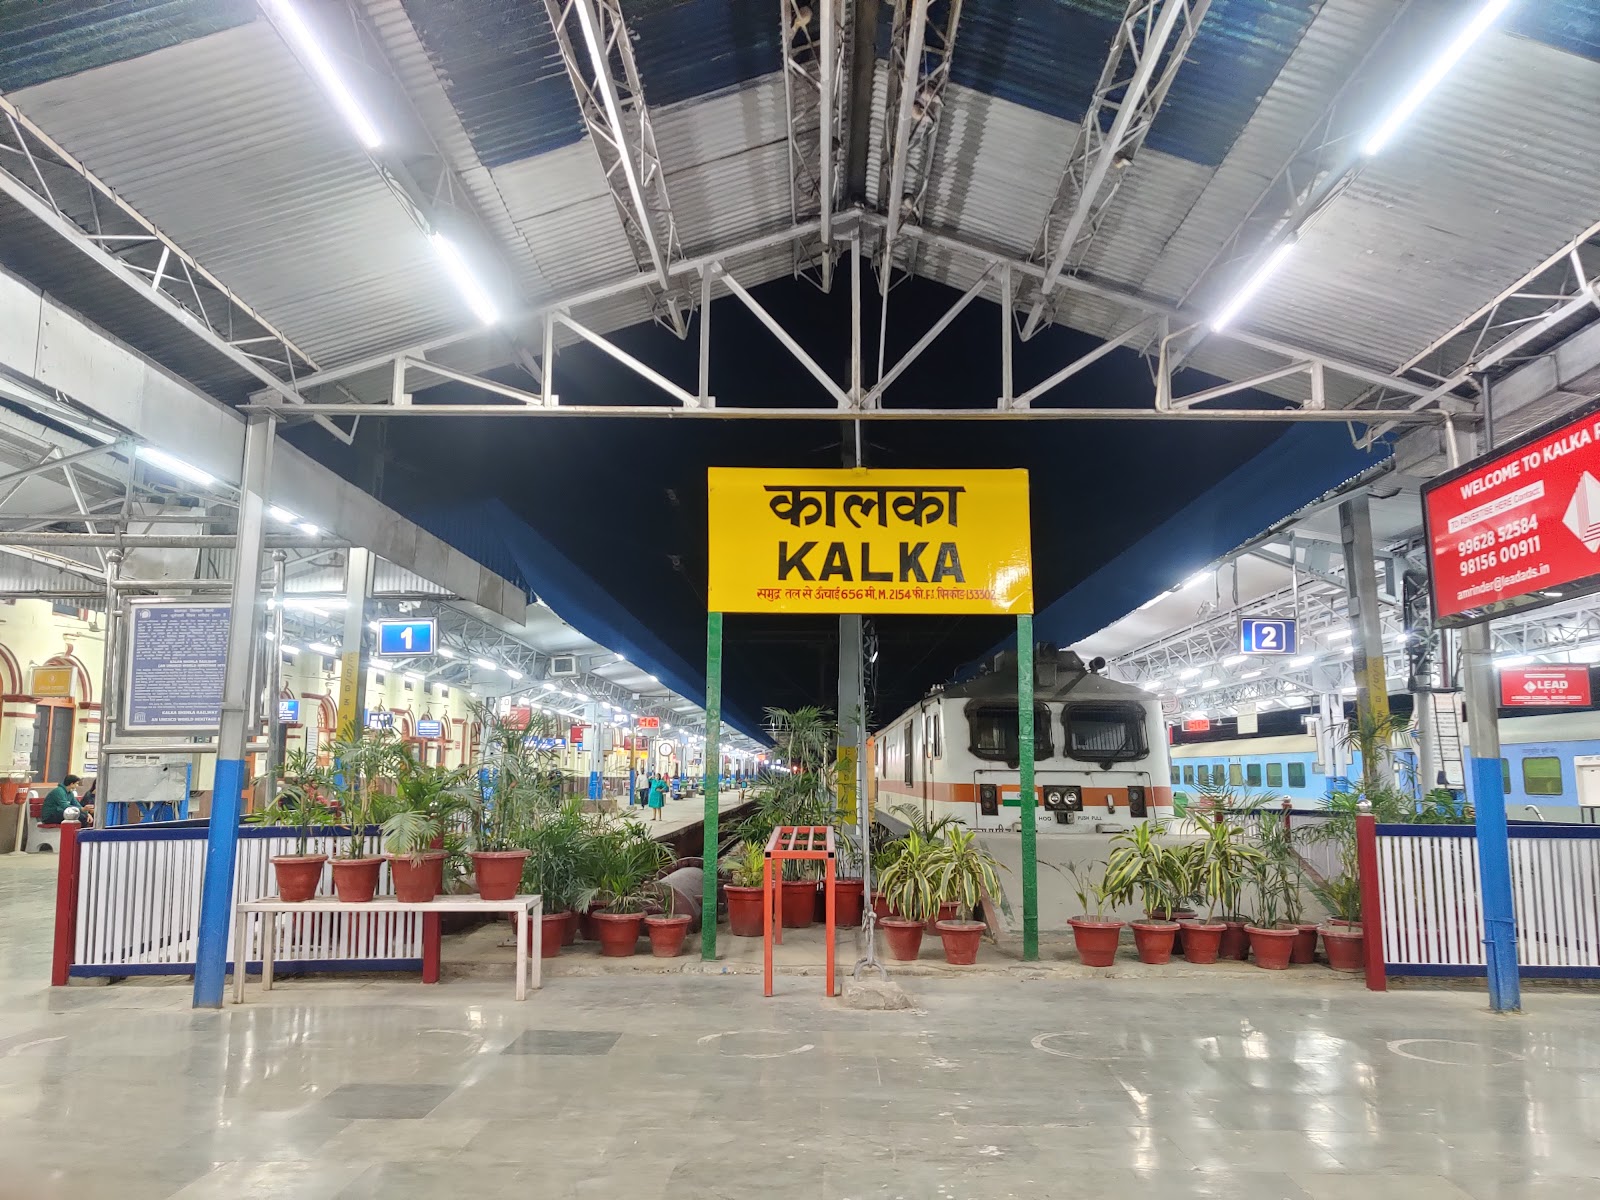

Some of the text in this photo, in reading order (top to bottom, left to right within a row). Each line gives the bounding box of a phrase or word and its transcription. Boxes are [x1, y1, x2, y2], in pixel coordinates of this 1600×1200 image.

[1460, 460, 1521, 500] WELCOME
[1521, 451, 1541, 472] TO
[1543, 429, 1592, 463] KALKA
[763, 485, 966, 528] कालका
[1457, 513, 1538, 557] 99628 52584
[778, 541, 966, 583] KALKA
[1459, 535, 1541, 577] 98156 00911
[756, 587, 782, 602] समुद्र
[785, 588, 802, 600] तल
[802, 586, 813, 600] से
[841, 589, 863, 599] 656
[889, 589, 912, 600] 2154
[1456, 562, 1551, 600] amrinder@leadads.in
[400, 626, 412, 649] 1
[1261, 626, 1277, 647] 2
[1537, 680, 1569, 689] LEAD
